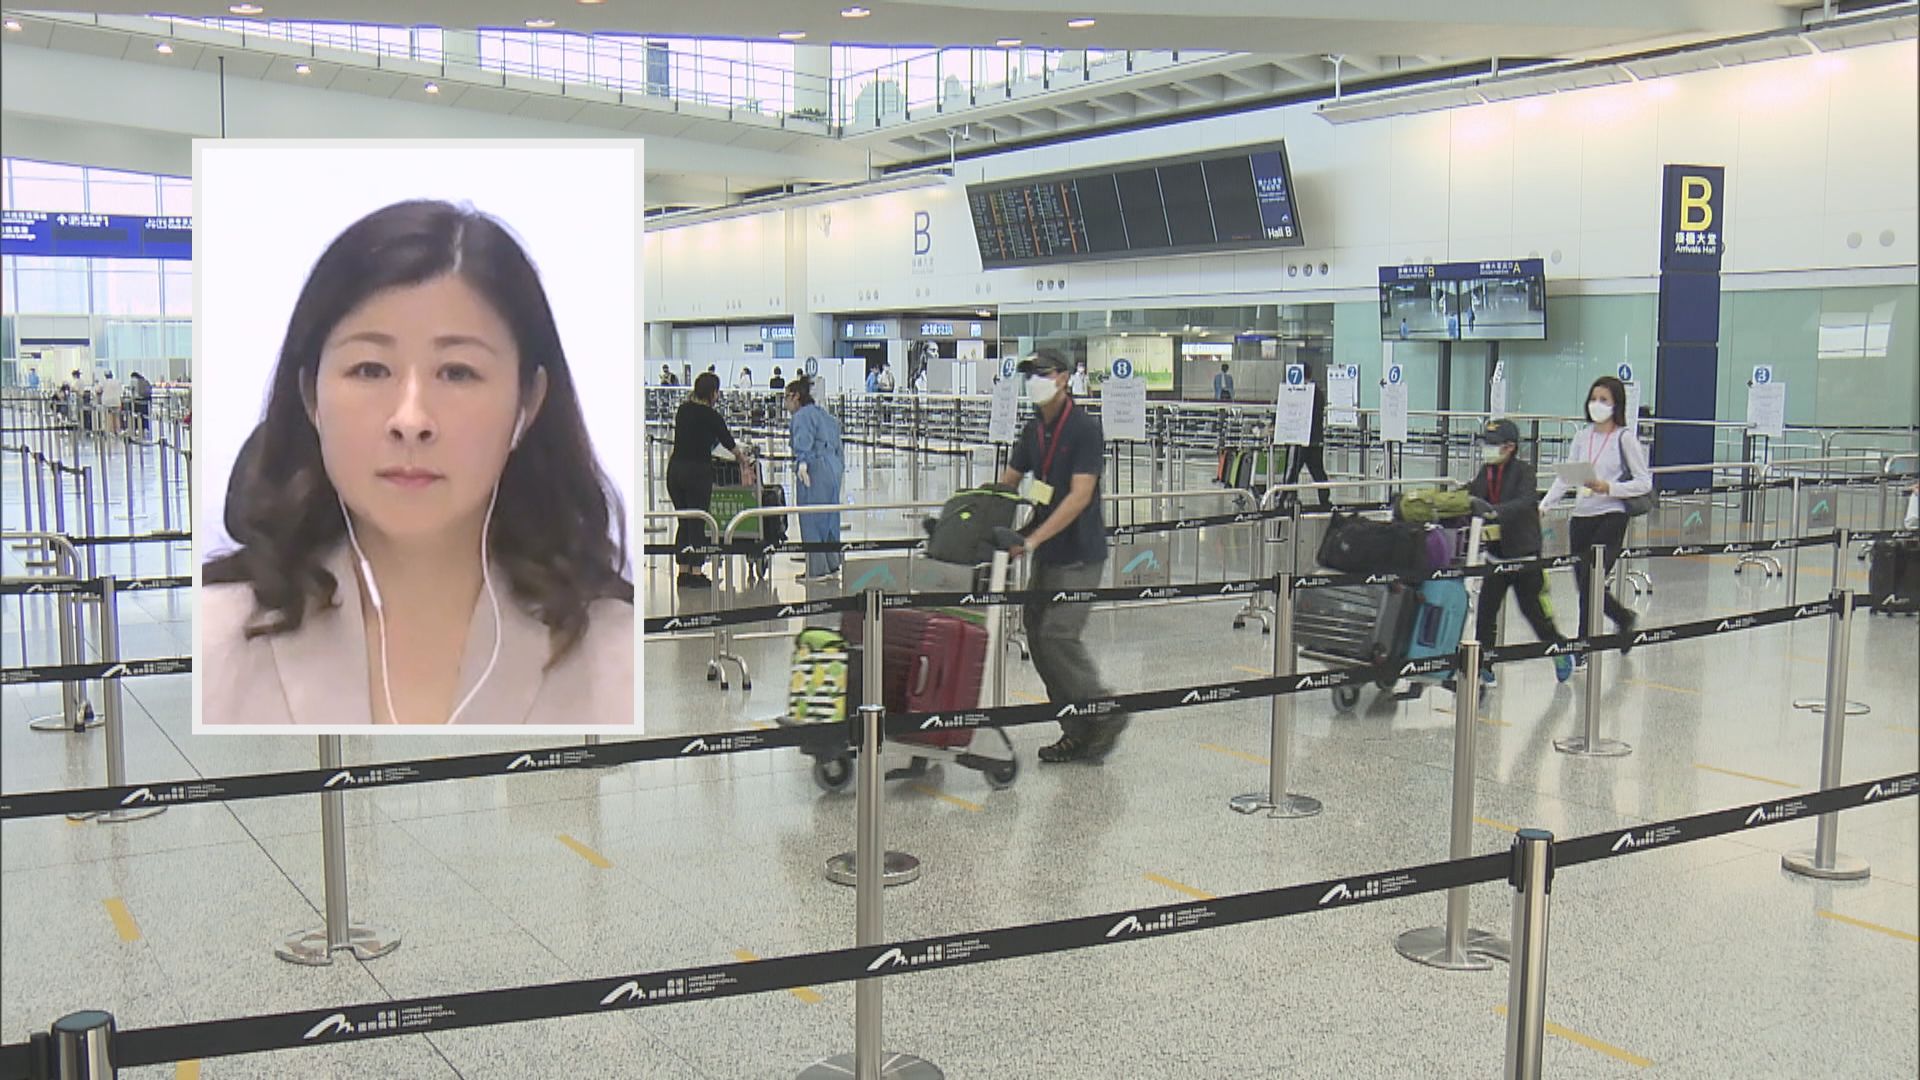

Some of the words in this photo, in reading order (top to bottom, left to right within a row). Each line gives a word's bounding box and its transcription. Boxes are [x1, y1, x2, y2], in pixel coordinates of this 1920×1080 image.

[1680, 176, 1713, 231] B
[914, 210, 931, 256] B
[1267, 227, 1284, 239] Hall
[1285, 226, 1292, 237] B
[1675, 232, 1717, 245] 接機大堂
[1675, 244, 1701, 254] Arrivals
[1702, 244, 1717, 254] Hall
[1428, 266, 1435, 277] B
[1513, 262, 1521, 273] A
[1117, 359, 1127, 375] 8
[1290, 369, 1300, 383] 7
[1390, 368, 1399, 382] 6
